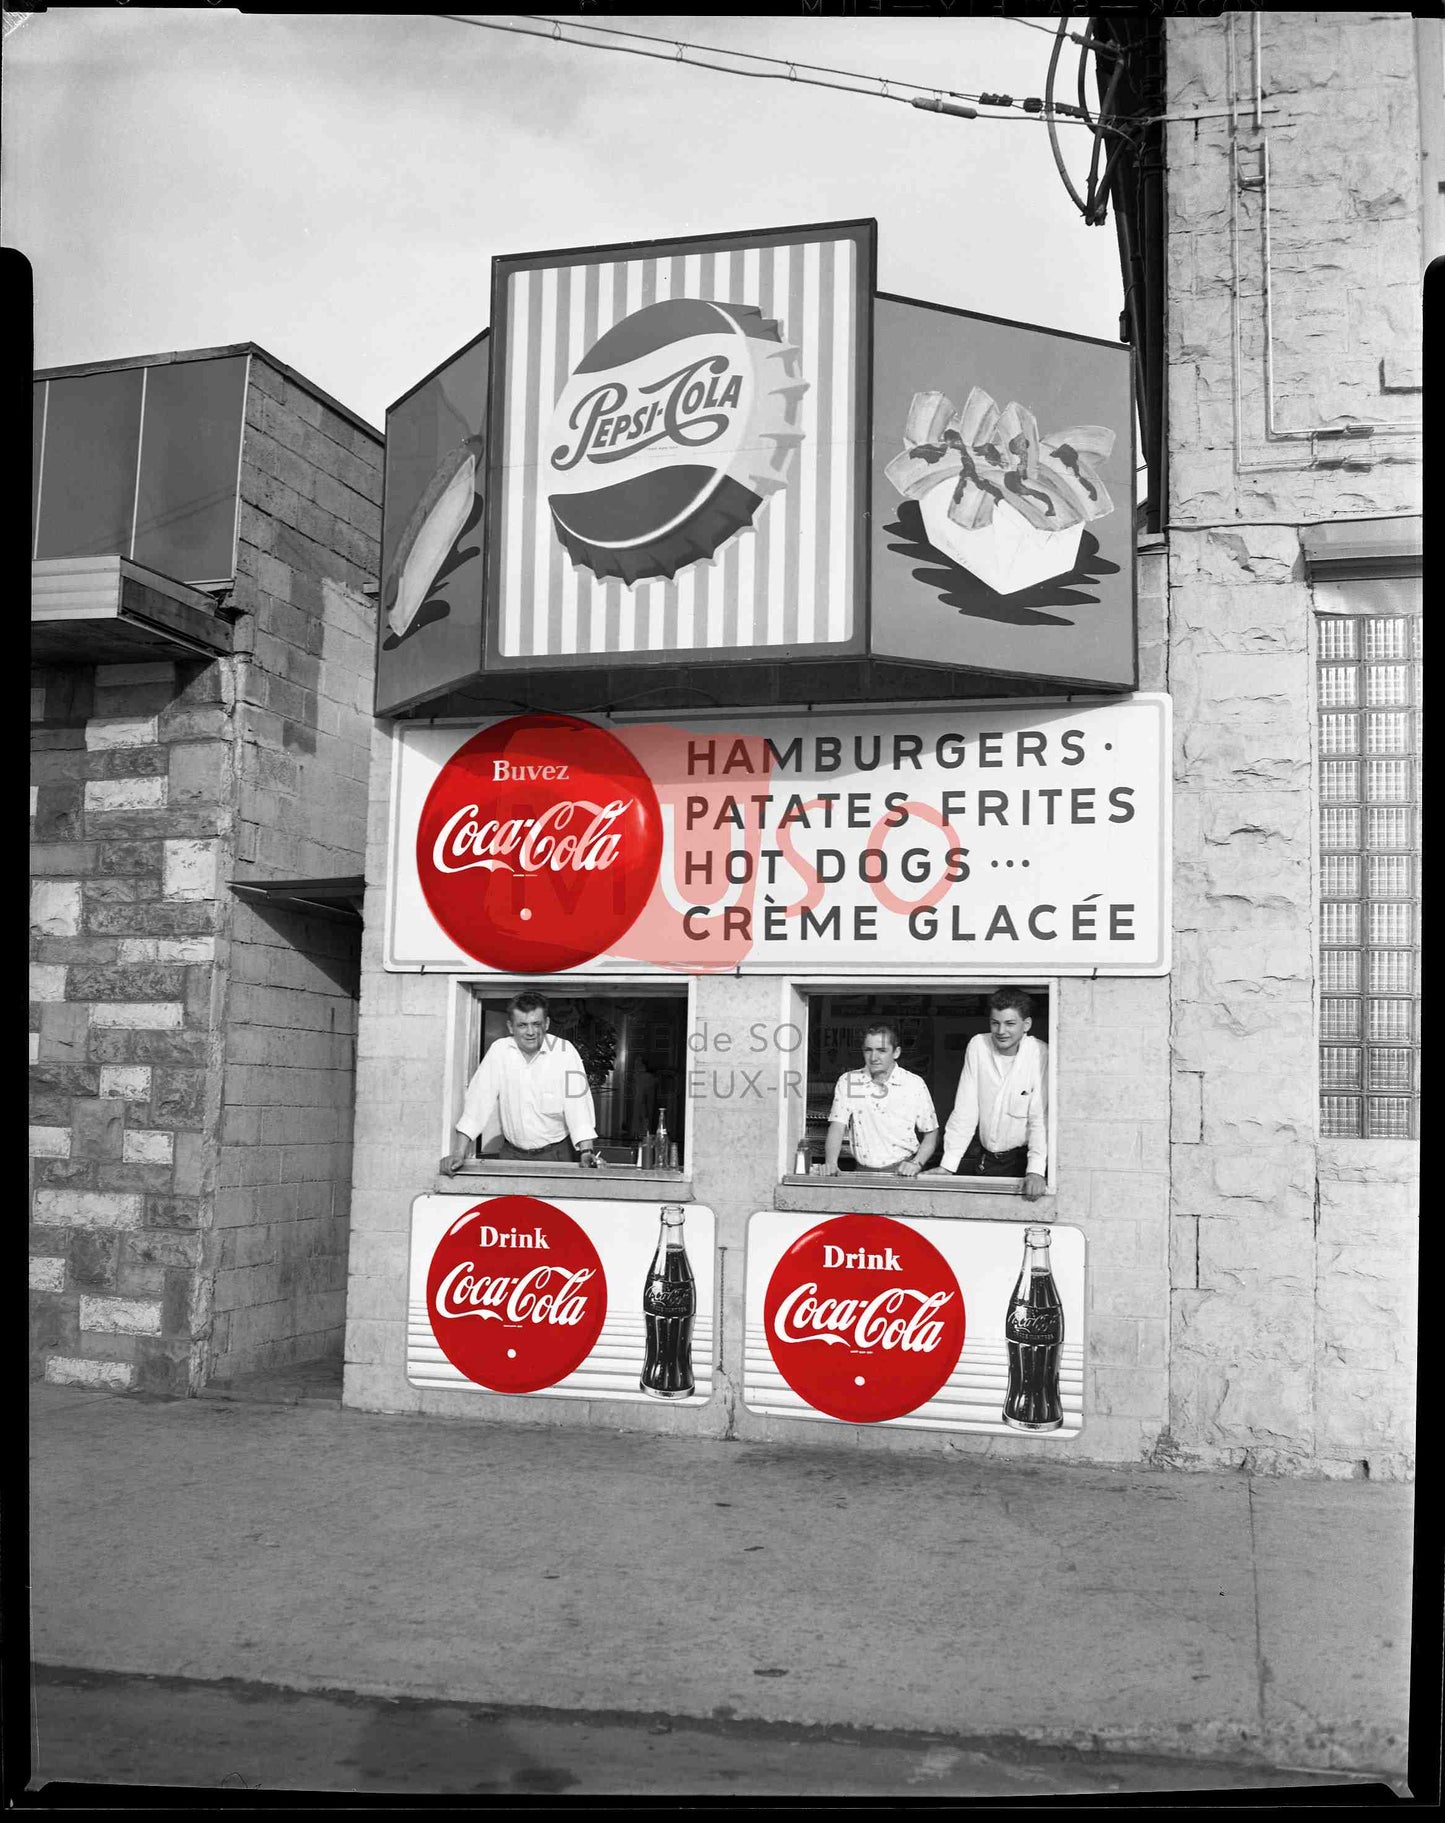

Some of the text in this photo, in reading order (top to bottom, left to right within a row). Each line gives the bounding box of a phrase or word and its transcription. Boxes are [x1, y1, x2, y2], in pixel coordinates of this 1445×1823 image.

[492, 760, 570, 782] Buvez
[686, 786, 1135, 831] PATATES FRITES
[433, 799, 634, 873] Coca-Cola
[685, 850, 784, 885] HOT
[683, 893, 1135, 941] CRÈME GLACÉE
[479, 1225, 551, 1250] Drink
[822, 1244, 904, 1272] Drink
[435, 1261, 597, 1327] Coca-Cola
[773, 1282, 955, 1354] Coca-Cola
